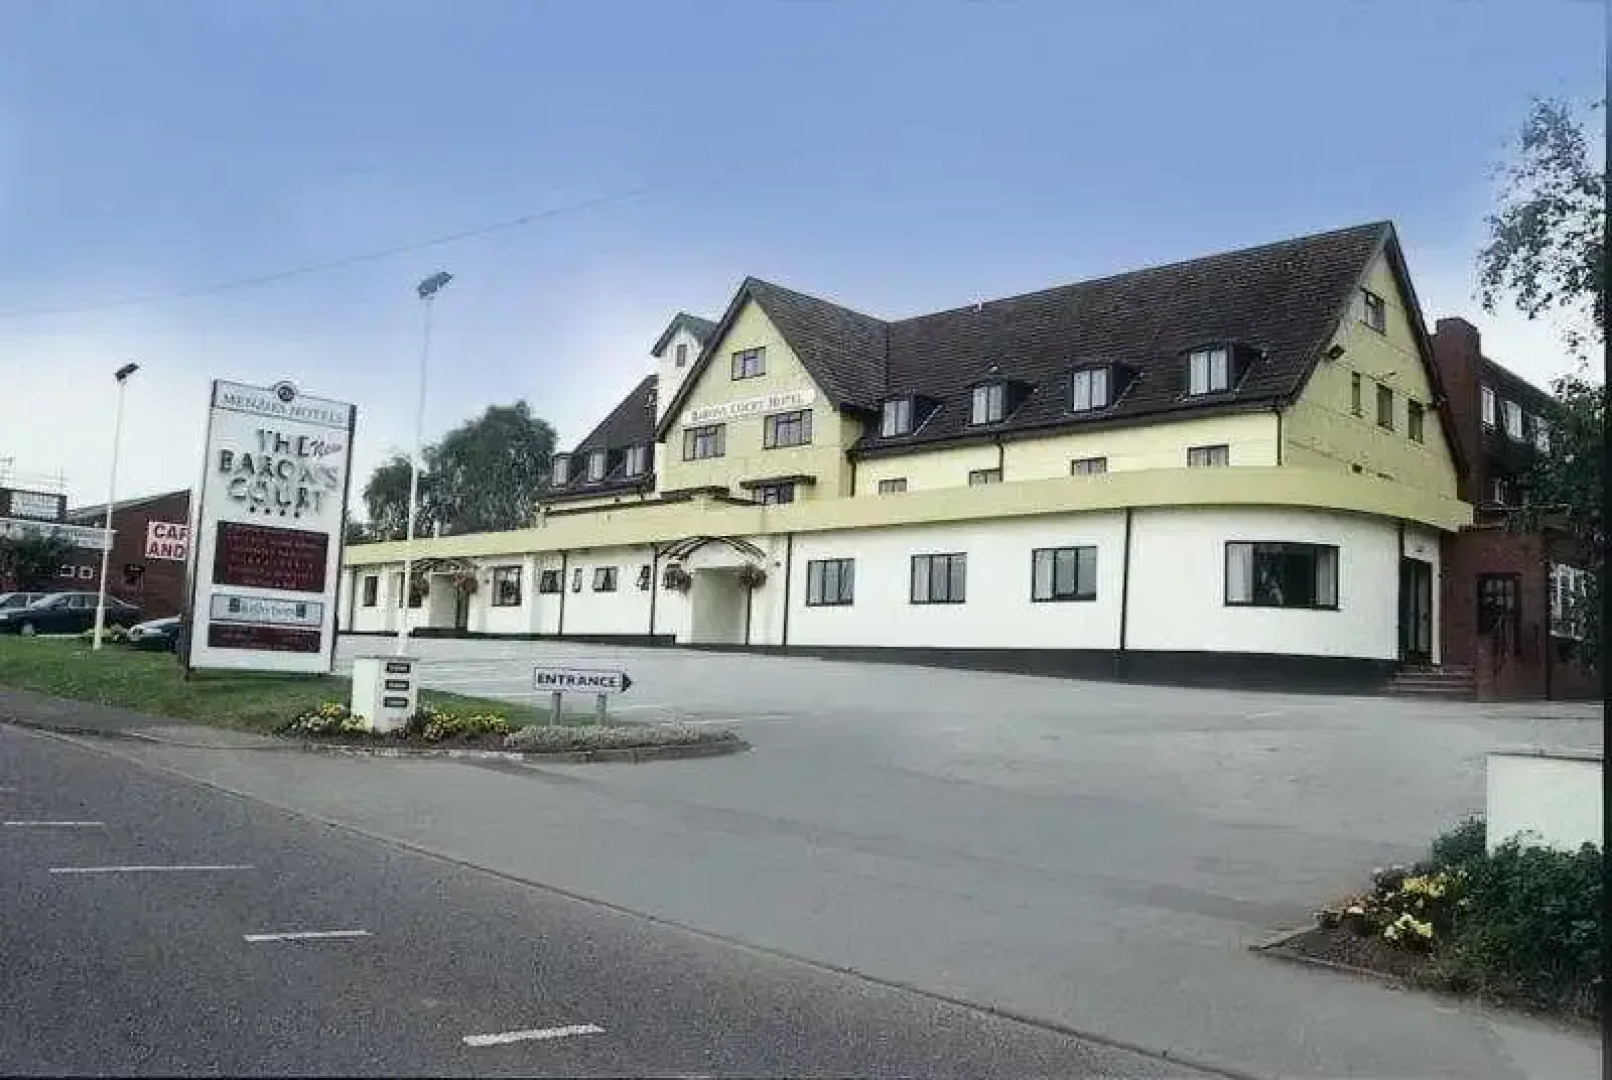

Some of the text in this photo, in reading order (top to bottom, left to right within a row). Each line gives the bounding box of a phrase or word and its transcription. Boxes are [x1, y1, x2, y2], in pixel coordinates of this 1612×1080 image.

[257, 429, 309, 458] THE
[149, 541, 184, 558] AND
[537, 673, 616, 687] ENTRANCE
